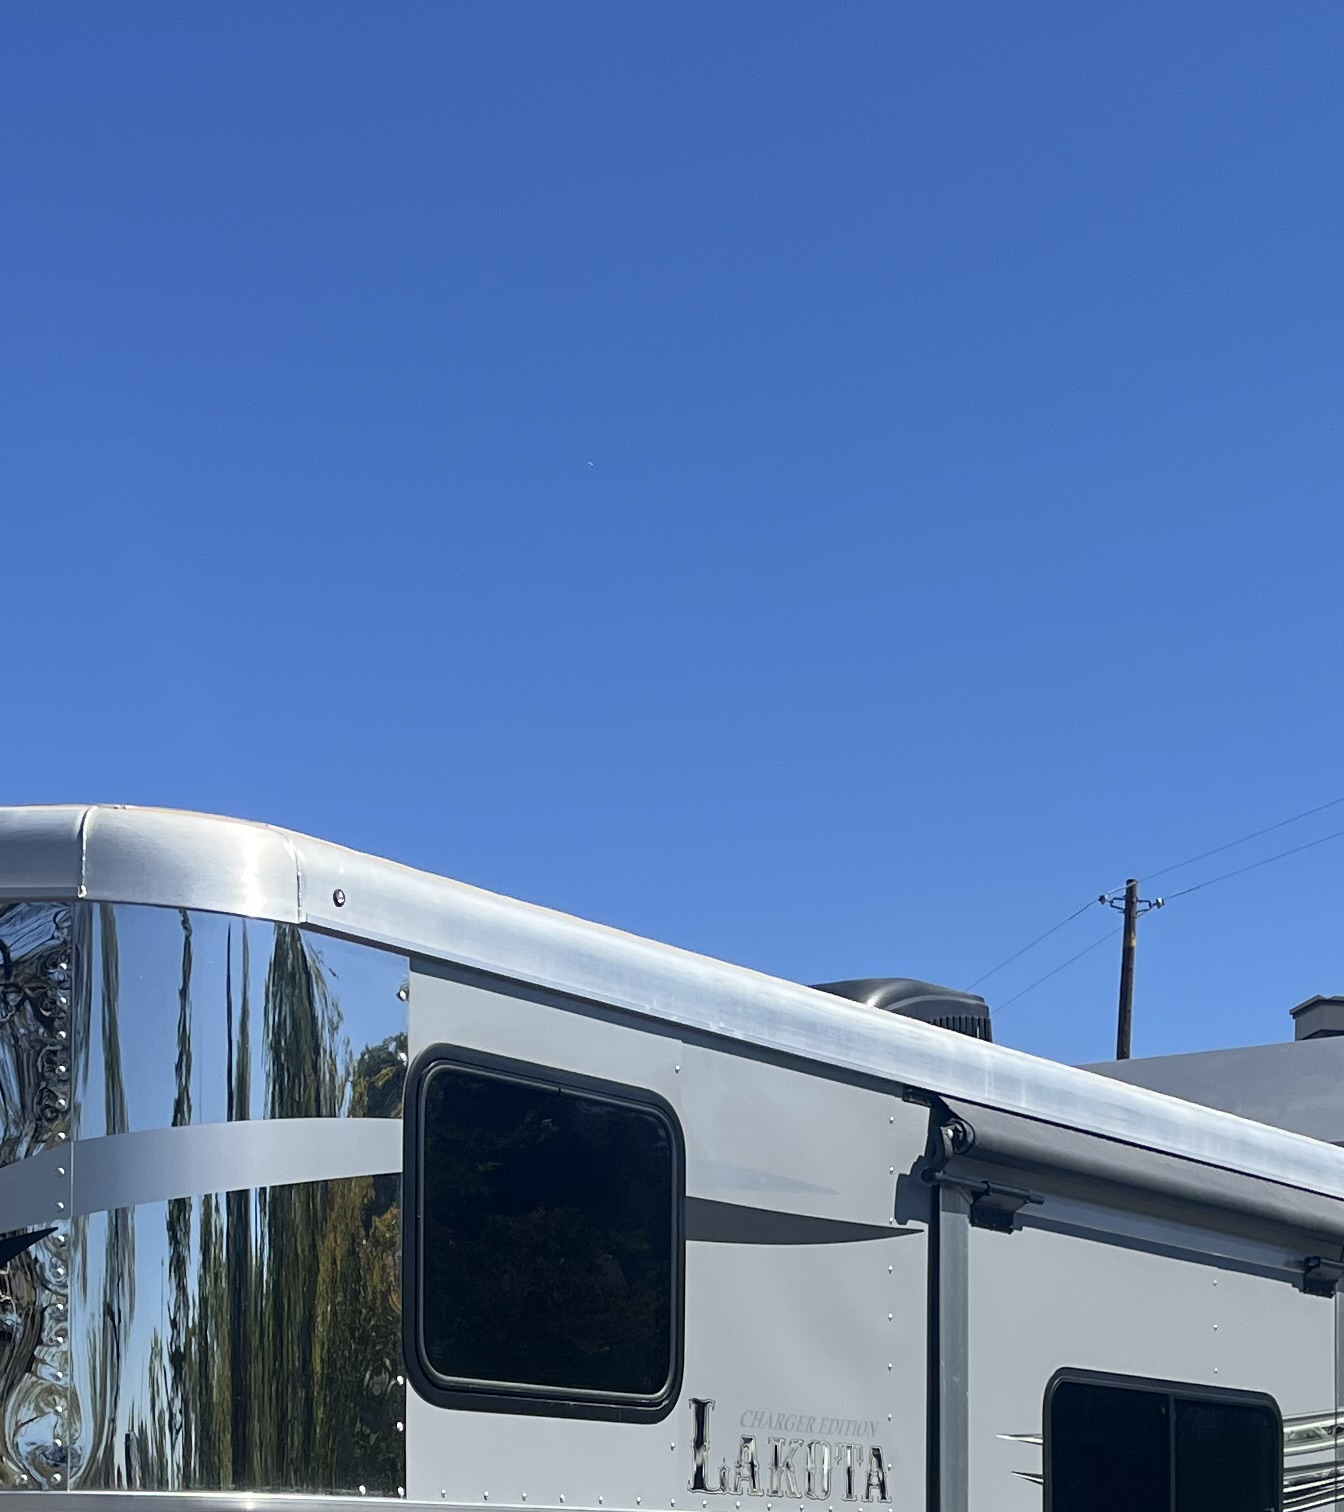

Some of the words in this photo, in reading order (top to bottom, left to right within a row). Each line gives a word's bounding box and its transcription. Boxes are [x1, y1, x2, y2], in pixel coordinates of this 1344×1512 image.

[687, 1397, 893, 1503] LAKOTA
[740, 1409, 816, 1434] CHARGER
[819, 1417, 880, 1438] EDITION
